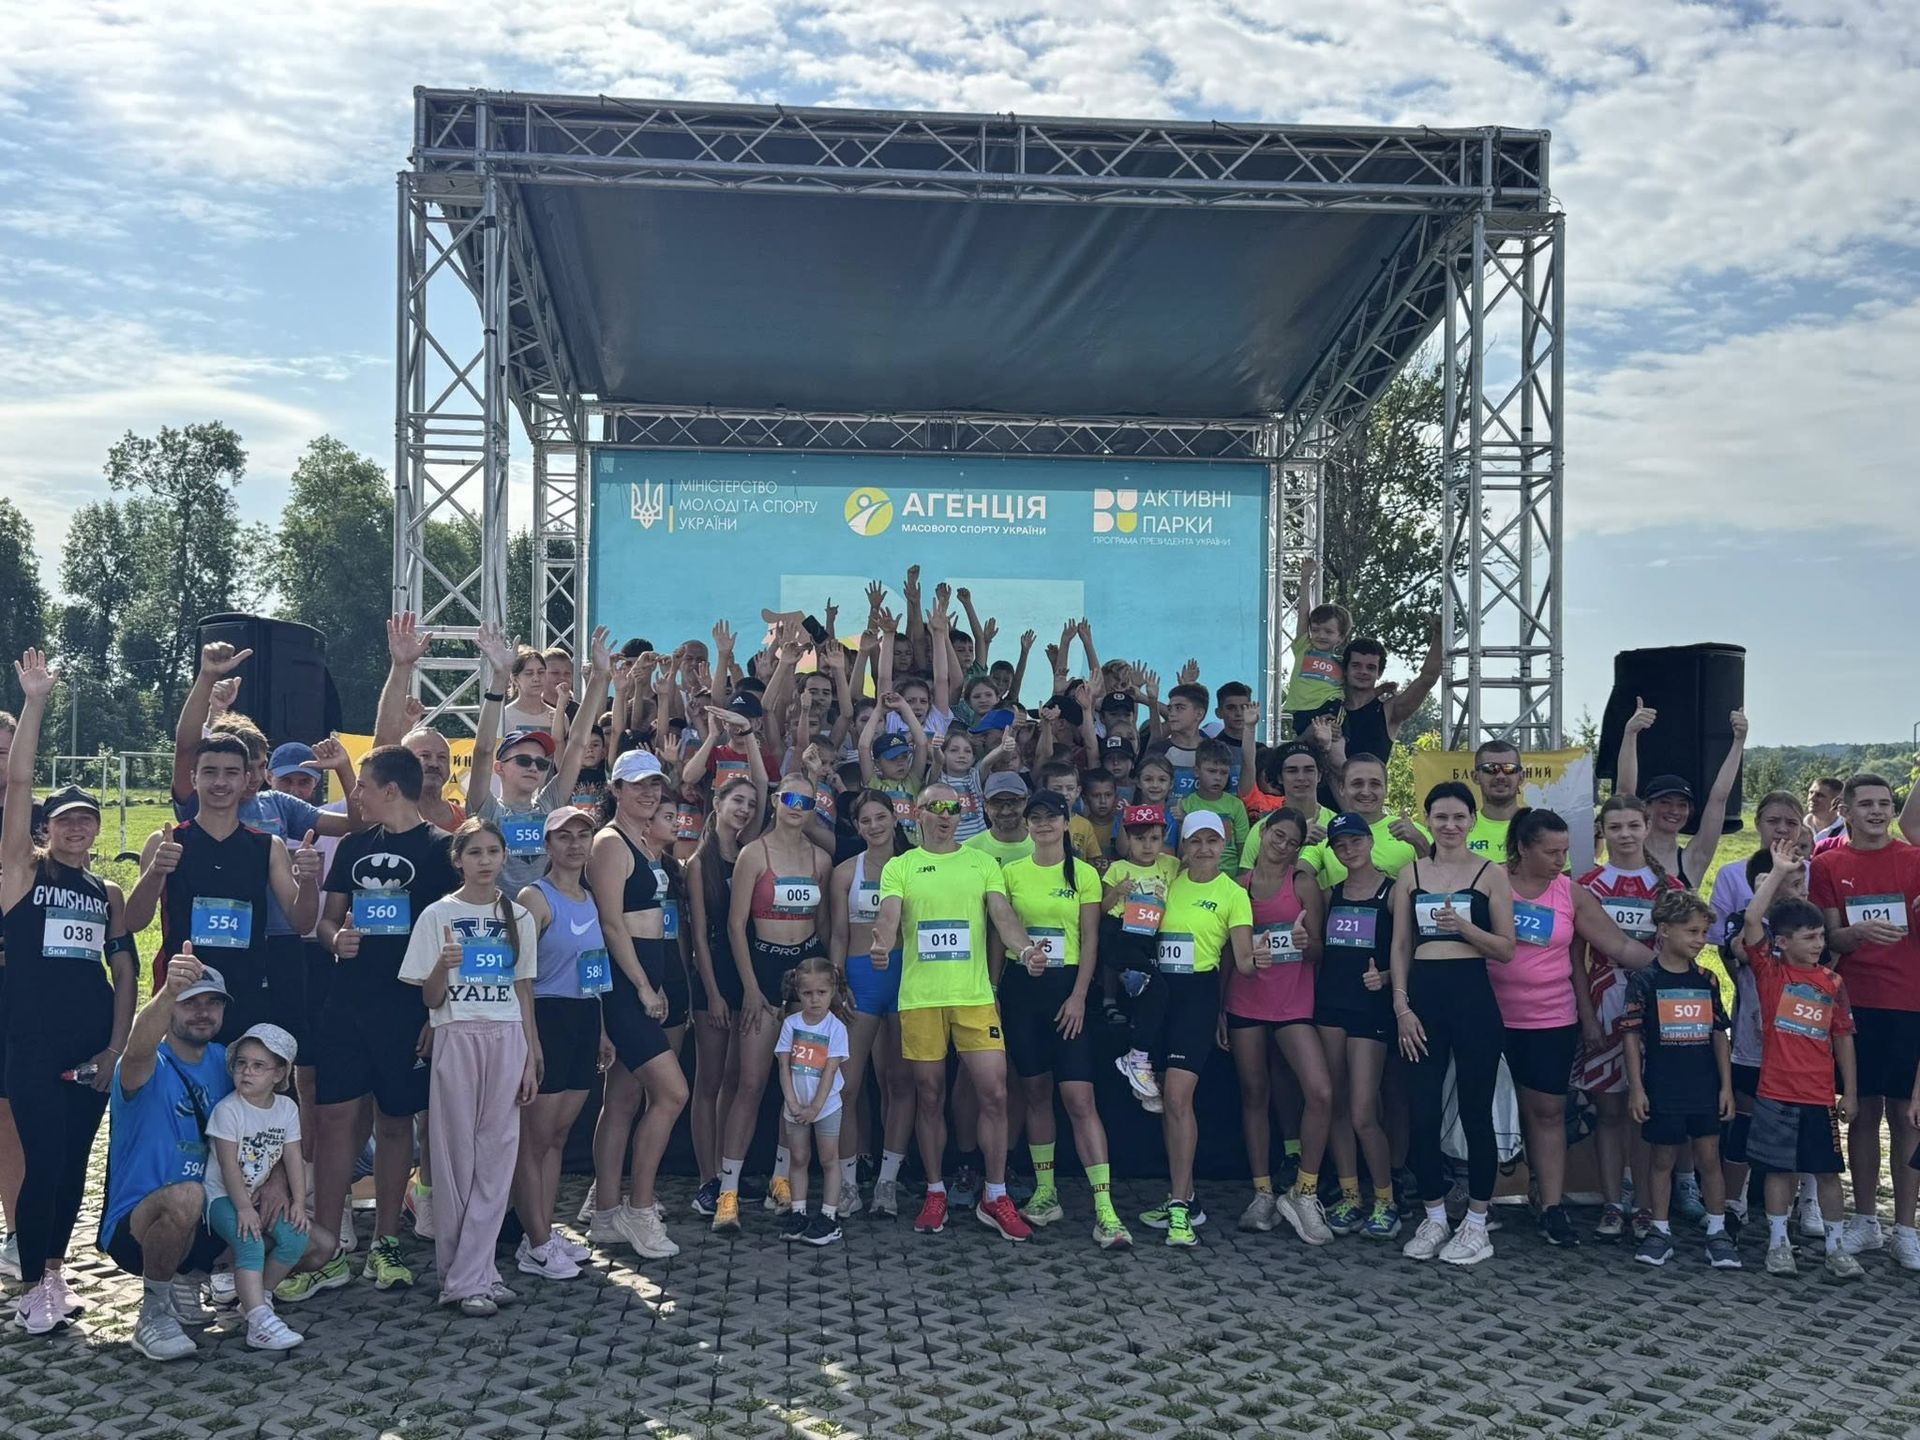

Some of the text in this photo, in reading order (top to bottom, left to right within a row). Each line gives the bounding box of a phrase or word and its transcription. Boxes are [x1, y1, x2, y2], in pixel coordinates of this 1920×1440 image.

[679, 480, 778, 494] МІНІСТЕРСТВО
[1142, 489, 1231, 508] АКТИВНІ
[679, 499, 818, 514] МОЛОДІ ТА СПОРТУ
[902, 492, 1047, 523] АГЕНЦІЯ
[679, 515, 737, 531] УКРАЇНИ
[901, 523, 1047, 536] МАСОВОГО СПОРТУ УКРАЇНИ
[1143, 515, 1213, 534] ПАРКИ
[1093, 535, 1139, 545] ПРОГРАМА
[1139, 536, 1194, 546] ПРЕЗИДЕНТА
[1312, 660, 1334, 673] 509
[516, 828, 540, 841] 556
[787, 889, 810, 901] 005
[33, 885, 109, 920] GYMSHARK
[367, 905, 397, 919] 560
[1616, 910, 1645, 925] 037
[208, 915, 239, 931] 554
[1336, 920, 1360, 932] 221
[1514, 915, 1540, 929] 572
[63, 925, 93, 942] 038
[932, 933, 957, 946] 018
[769, 945, 801, 956] PRO
[1160, 945, 1181, 958] 010
[476, 954, 504, 967] 591
[448, 985, 512, 1001] YALE
[1674, 1004, 1701, 1017] 507
[1793, 1003, 1823, 1021] 526
